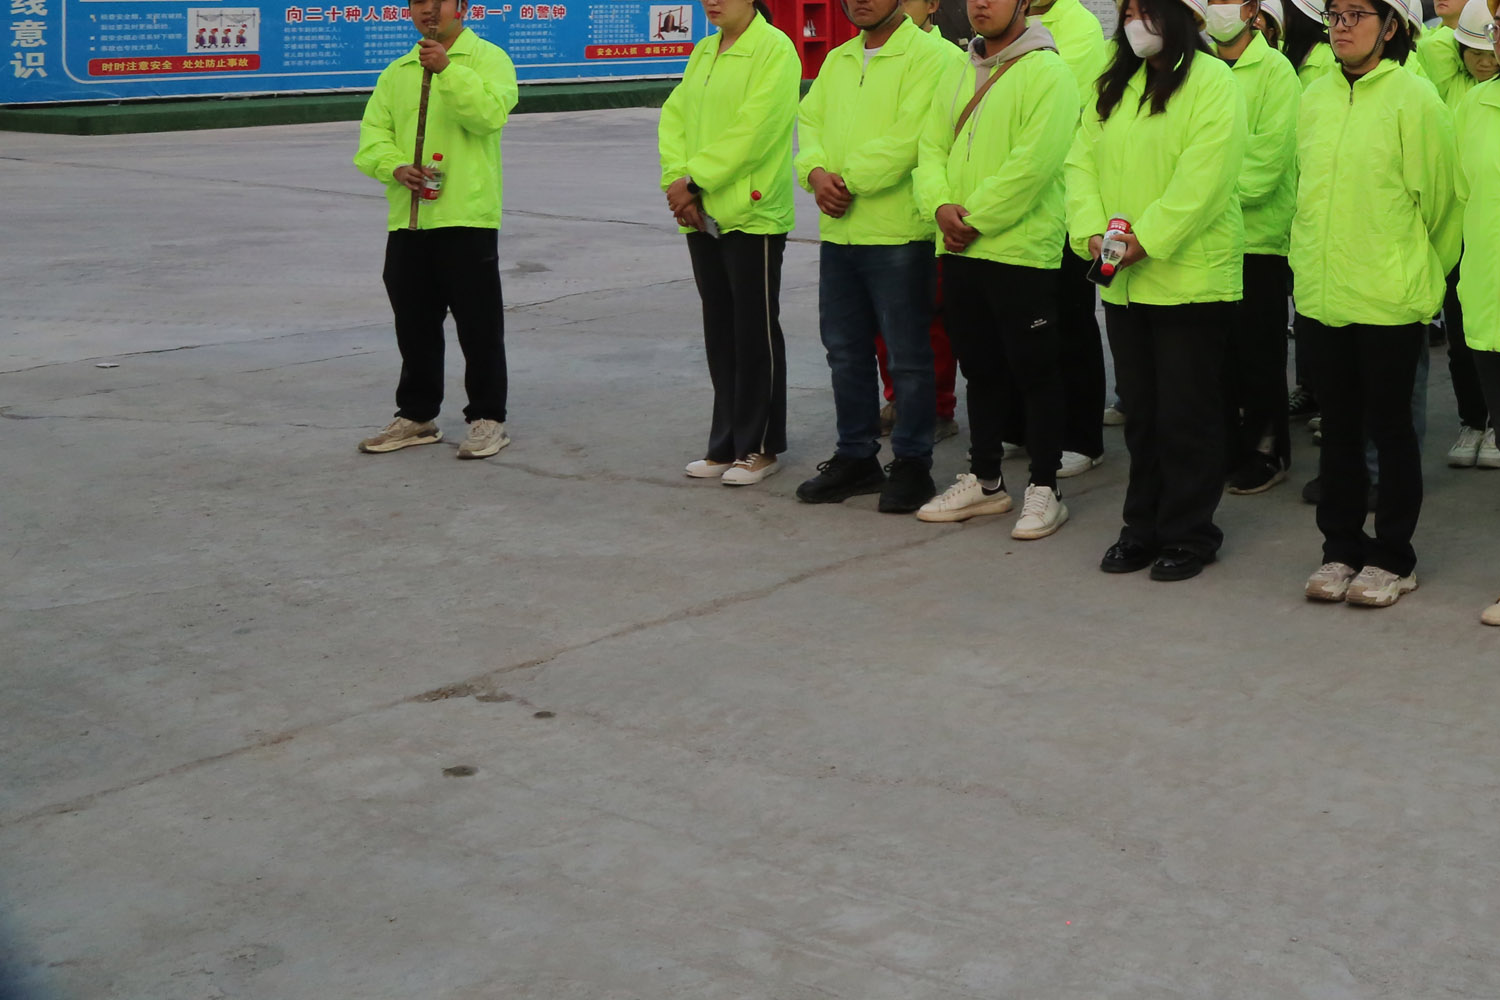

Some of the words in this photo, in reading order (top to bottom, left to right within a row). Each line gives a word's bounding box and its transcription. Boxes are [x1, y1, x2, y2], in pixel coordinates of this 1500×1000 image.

[102, 61, 173, 72] 时时注意安全
[183, 57, 249, 70] 处处防止事故
